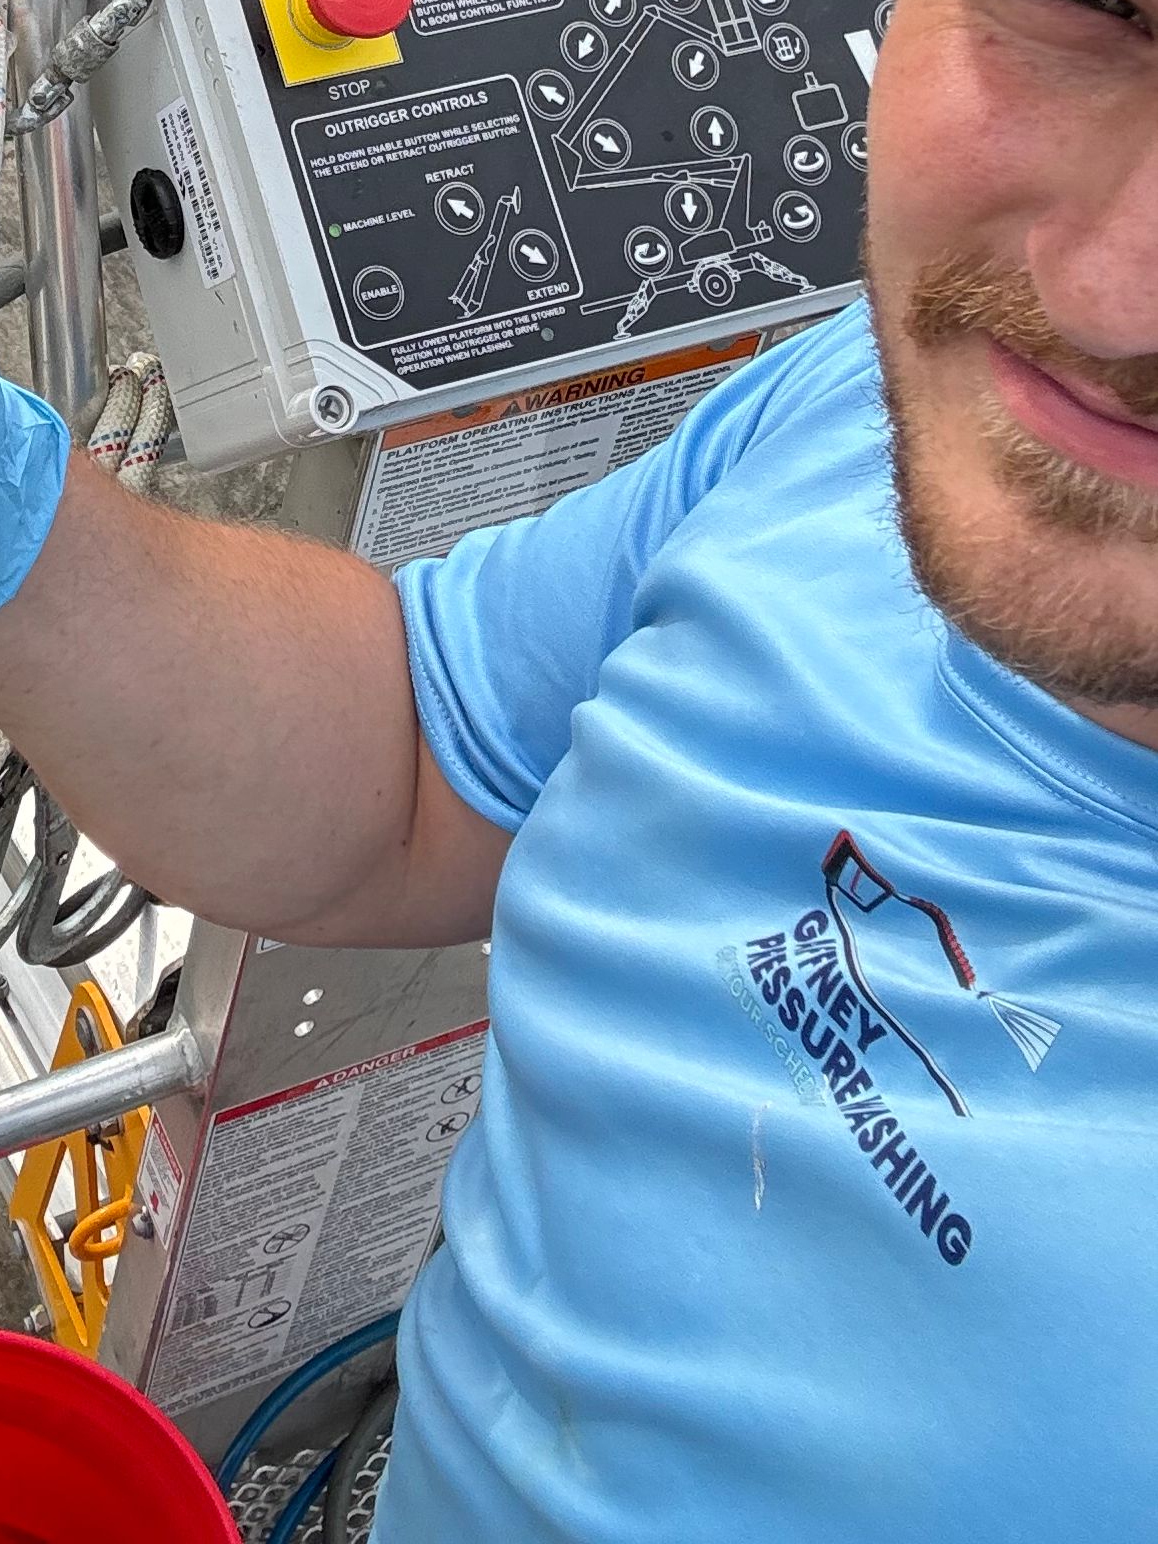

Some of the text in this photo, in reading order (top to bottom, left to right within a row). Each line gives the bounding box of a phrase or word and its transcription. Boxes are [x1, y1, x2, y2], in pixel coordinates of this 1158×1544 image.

[416, 1, 456, 17] BUTTON
[420, 18, 428, 28] A
[428, 13, 458, 27] BOOM
[460, 2, 506, 20] CONTROL
[328, 79, 371, 101] STOP
[324, 91, 489, 138] OUTRIGGER CONTROLS
[310, 114, 521, 169] HOLD DOWN ENABLE BUTTON WHILE SELECTING
[313, 168, 332, 179] THE
[333, 159, 370, 175] EXTEND
[372, 155, 385, 167] OR
[386, 146, 427, 162] RETRACT
[428, 134, 481, 152] OUTRIGGER
[424, 163, 475, 184] RETRACT
[343, 209, 416, 233] MACHINE LEVEL
[360, 284, 399, 302] ENABLE
[527, 282, 570, 301] EXTEND
[391, 306, 566, 357] FULLY LOWER PLATFORM INTO THE STOWED
[394, 324, 540, 366] POSITION FOR OUTRIGGER OR DRIVE
[397, 358, 444, 376] OPERATION
[445, 352, 471, 365] WHEN
[525, 367, 645, 411] WARNING
[386, 434, 458, 460] PLATFORM
[461, 411, 538, 440] OPERATING
[540, 388, 636, 420] INSTRUCTIONS
[639, 373, 700, 395] ARTICULATING
[703, 365, 732, 377] MODEL
[332, 1046, 418, 1084] DANGER
